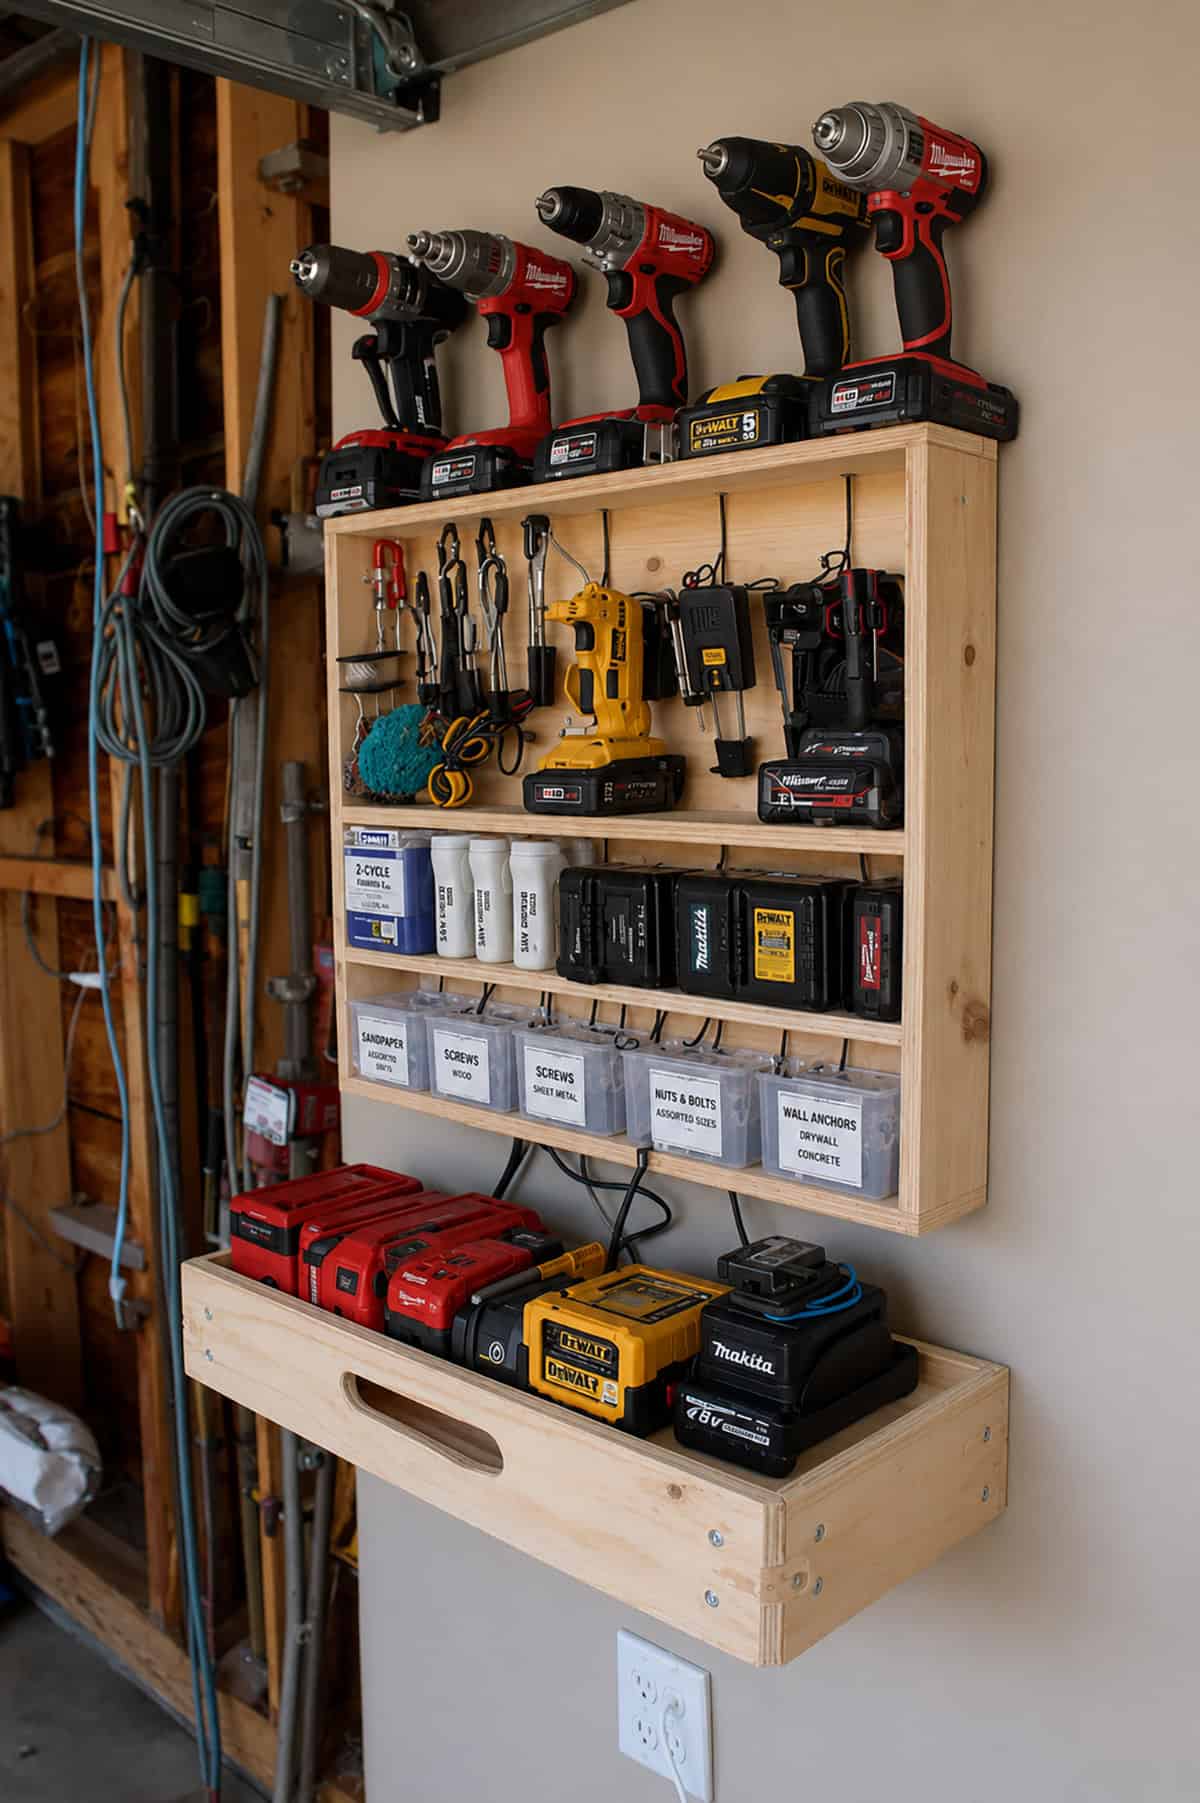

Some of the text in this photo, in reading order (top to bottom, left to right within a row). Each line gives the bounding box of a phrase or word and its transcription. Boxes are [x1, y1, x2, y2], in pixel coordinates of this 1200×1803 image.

[355, 863, 391, 878] 2-CYCLE
[361, 1031, 404, 1050] SANDPAPER
[444, 1048, 480, 1067] SCREWS
[535, 1065, 575, 1085] SCREWS
[555, 1088, 578, 1103] METAL
[655, 1087, 717, 1111] NUTS & BOLTS
[656, 1108, 717, 1129] ASSORTED SIZES
[783, 1105, 857, 1132] WALL ANCHORS
[799, 1130, 839, 1148] DRYWALL
[797, 1148, 841, 1167] CONCRETE
[711, 1340, 777, 1376] Makita
